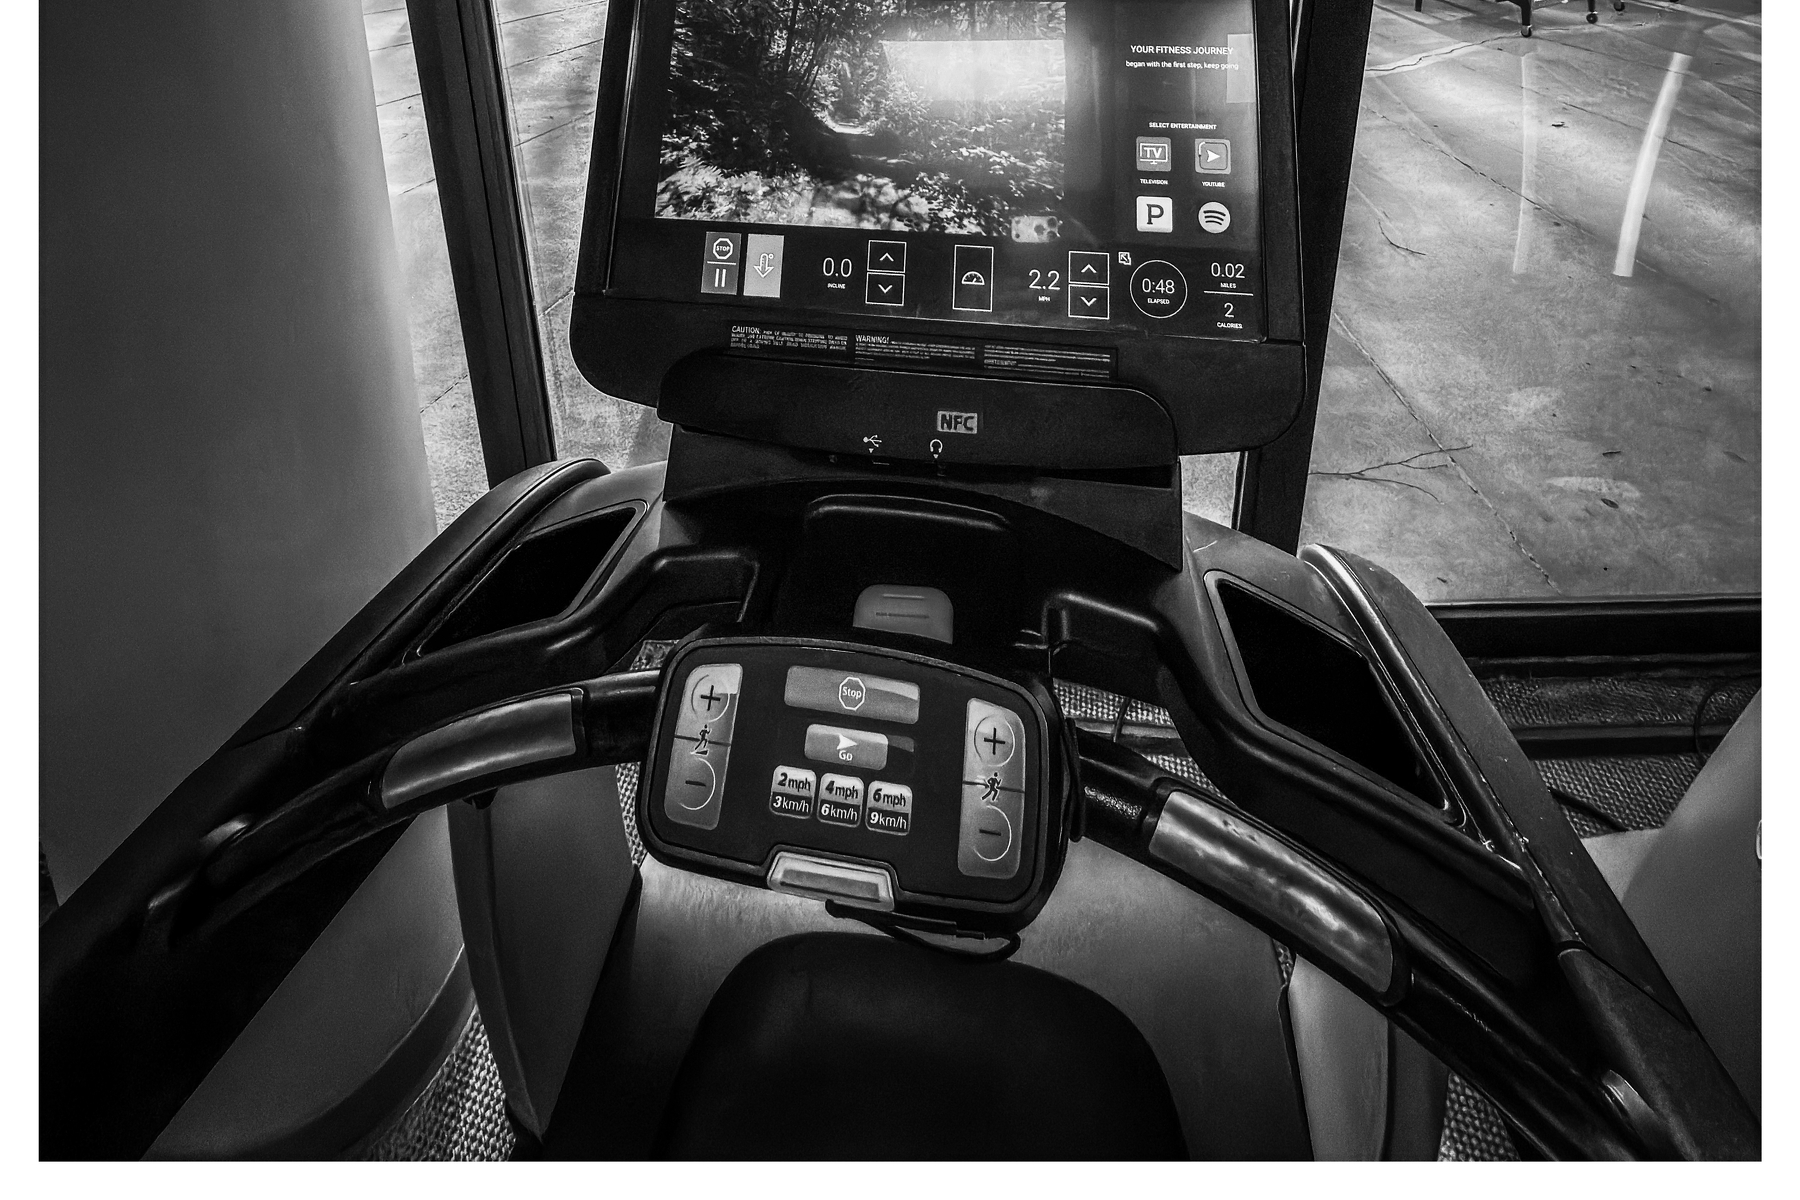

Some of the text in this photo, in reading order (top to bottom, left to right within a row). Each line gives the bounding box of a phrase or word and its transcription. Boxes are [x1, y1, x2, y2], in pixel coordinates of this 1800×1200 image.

[1130, 45, 1234, 55] YOUR FITNESS JOURNEY
[1125, 60, 1145, 68] began
[1146, 60, 1160, 68] with
[1161, 60, 1172, 68] the
[1172, 60, 1186, 68] first
[1203, 61, 1220, 70] keep
[1220, 62, 1239, 70] going
[1170, 122, 1218, 130] ENTERTAINMENT
[1143, 147, 1163, 159] TV
[1146, 203, 1164, 225] P
[822, 257, 852, 278] 0.0
[1210, 262, 1246, 279] 0.02
[1028, 269, 1061, 290] 2.2
[1141, 278, 1175, 294] 0:48
[1223, 302, 1235, 318] 2
[1216, 321, 1243, 329] CALORIES
[855, 334, 890, 345] WARNING!
[940, 412, 975, 432] NFC
[842, 686, 862, 700] Stop
[838, 750, 853, 761] Go
